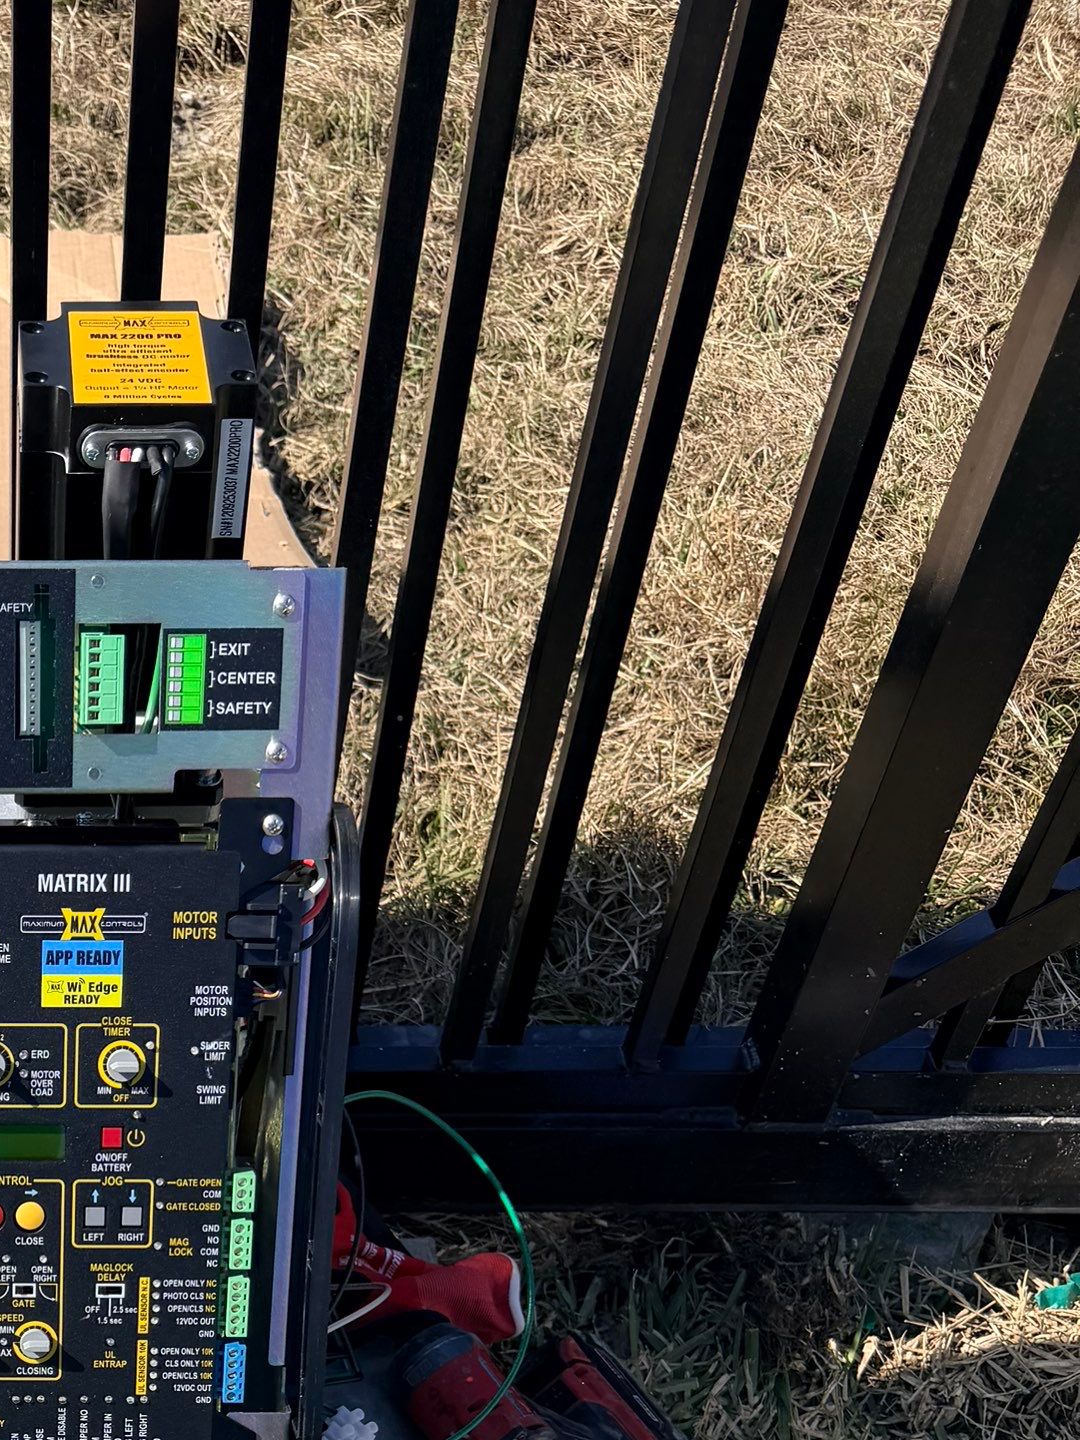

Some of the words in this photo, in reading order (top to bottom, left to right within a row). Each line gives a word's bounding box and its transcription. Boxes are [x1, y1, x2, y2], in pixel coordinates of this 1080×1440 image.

[224, 420, 244, 476] MAX2200PRO
[219, 643, 250, 655] EXIT
[217, 672, 275, 684] CENTER
[216, 702, 272, 714] SAFETY
[38, 873, 107, 892] MATRIX
[114, 873, 130, 892] III
[173, 912, 218, 924] MOTOR
[70, 916, 97, 934] MAX
[173, 928, 216, 940] INPUTS
[46, 950, 72, 966] APP
[76, 950, 120, 966] READY
[88, 982, 118, 995] Edge
[195, 986, 228, 995] MOTOR
[64, 995, 100, 1004] READY
[190, 997, 232, 1006] POSITION
[194, 1008, 227, 1017] INPUTS
[102, 1017, 132, 1026] CLOSE
[103, 1028, 131, 1036] TIMER
[196, 1086, 226, 1094] SWING
[199, 1096, 222, 1104] LIMIT
[95, 1153, 128, 1162] ON/OFF
[91, 1163, 132, 1172] BATTERY
[102, 1176, 123, 1186] JOG
[15, 1237, 44, 1245] CLOSE
[83, 1233, 104, 1241] LEFT
[118, 1233, 144, 1241] RIGHT
[90, 1264, 133, 1272] MAGLOCK
[97, 1274, 126, 1282] DELAY
[58, 1408, 66, 1435] DISABLE
